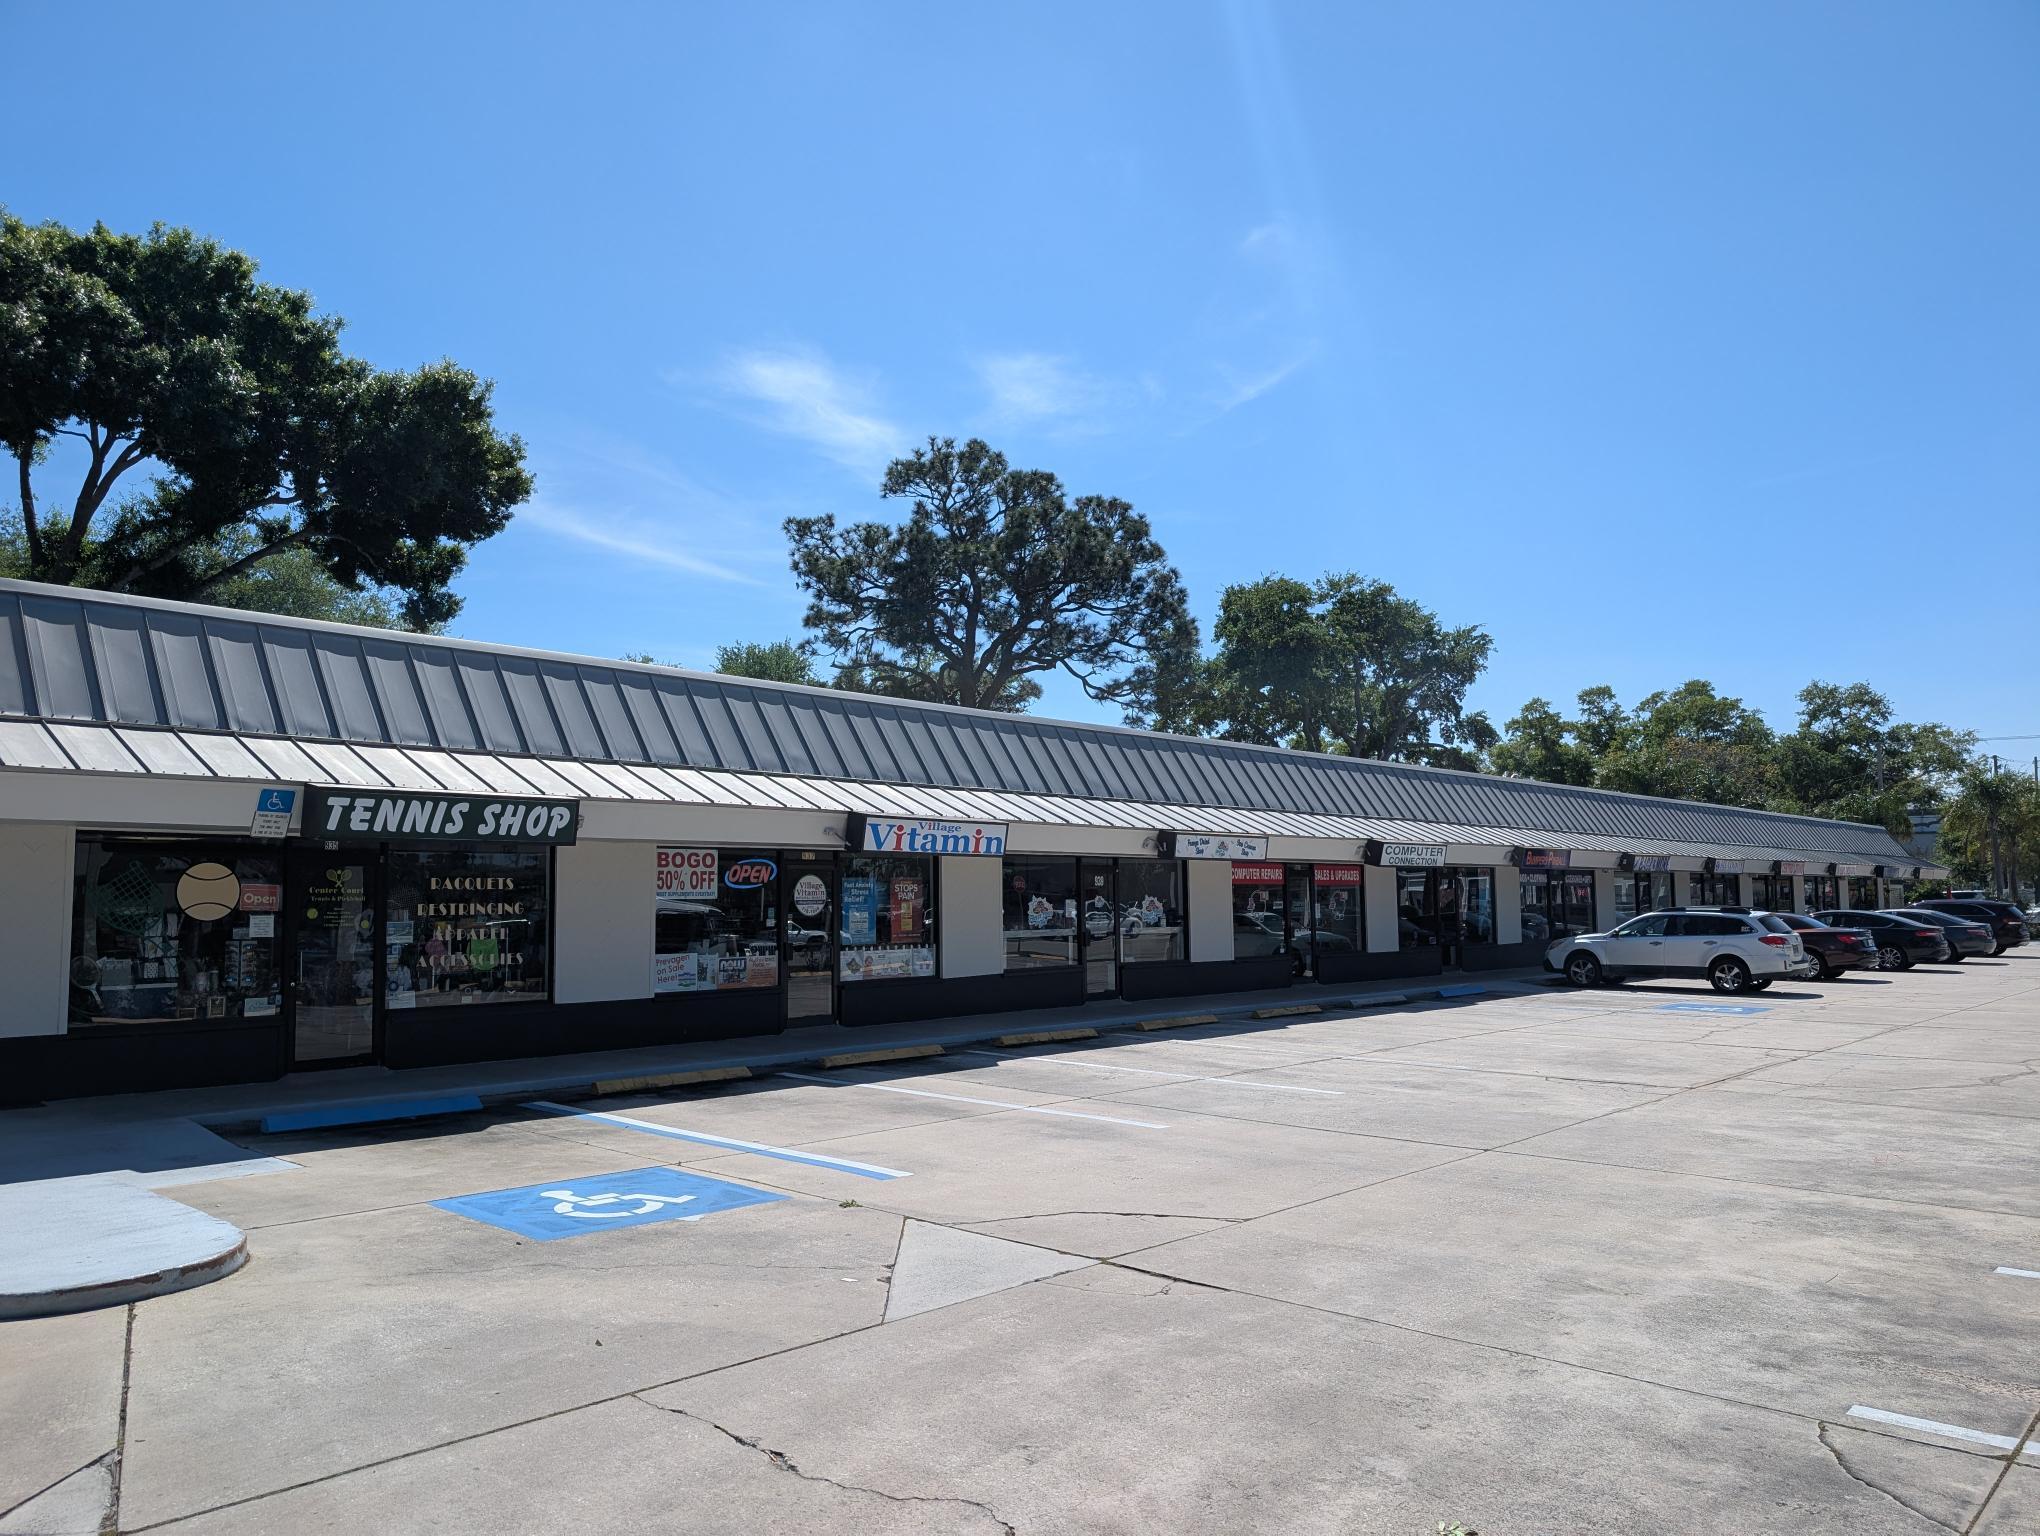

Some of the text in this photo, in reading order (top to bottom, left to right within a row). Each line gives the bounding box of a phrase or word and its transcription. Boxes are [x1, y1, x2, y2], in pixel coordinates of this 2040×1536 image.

[326, 796, 571, 838] TENNIS SHOP
[918, 821, 962, 833] Village
[868, 824, 1003, 854] Vitamin
[1385, 845, 1444, 857] COMPUTER
[657, 852, 716, 869] BOGO
[1388, 856, 1438, 866] CONNECTION
[728, 864, 770, 883] OPEN
[1231, 868, 1283, 880] COMPUTER REPAIRS
[1315, 869, 1330, 881] SALES
[1335, 870, 1360, 881] UPGRADES
[431, 878, 514, 889] RACQUETS
[656, 870, 717, 891] 50% OFF
[799, 882, 824, 891] Village
[309, 886, 364, 894] Center Court
[894, 884, 918, 893] STOPS
[243, 893, 276, 906] Open
[898, 892, 915, 901] PAIN
[417, 903, 524, 915] RESTRINGING
[416, 953, 523, 967] ACCESSORIES
[656, 955, 690, 967] Prevagen
[669, 963, 684, 973] Sale
[657, 975, 678, 984] Here!
